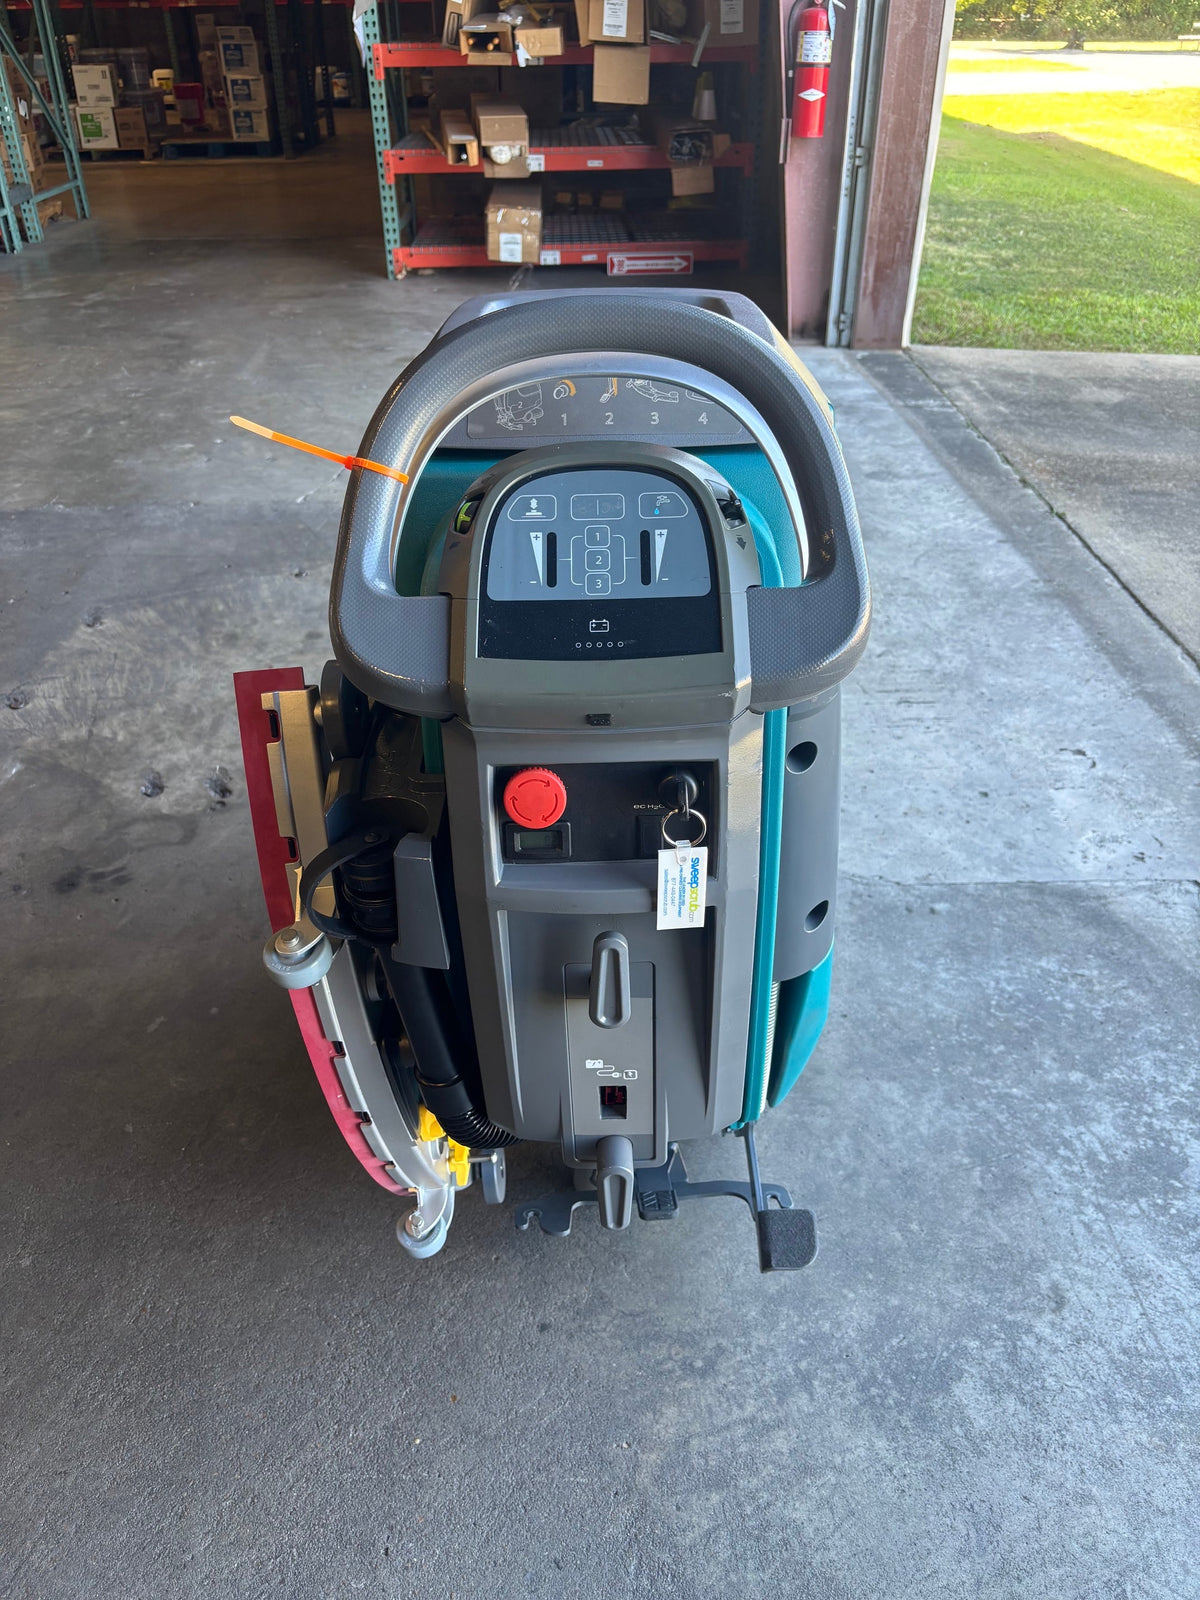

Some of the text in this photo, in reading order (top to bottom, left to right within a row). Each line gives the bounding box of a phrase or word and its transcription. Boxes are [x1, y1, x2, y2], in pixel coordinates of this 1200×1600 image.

[560, 411, 708, 426] 1 2 3 4
[596, 532, 600, 541] 1
[596, 556, 602, 564] 2
[596, 580, 602, 588] 3
